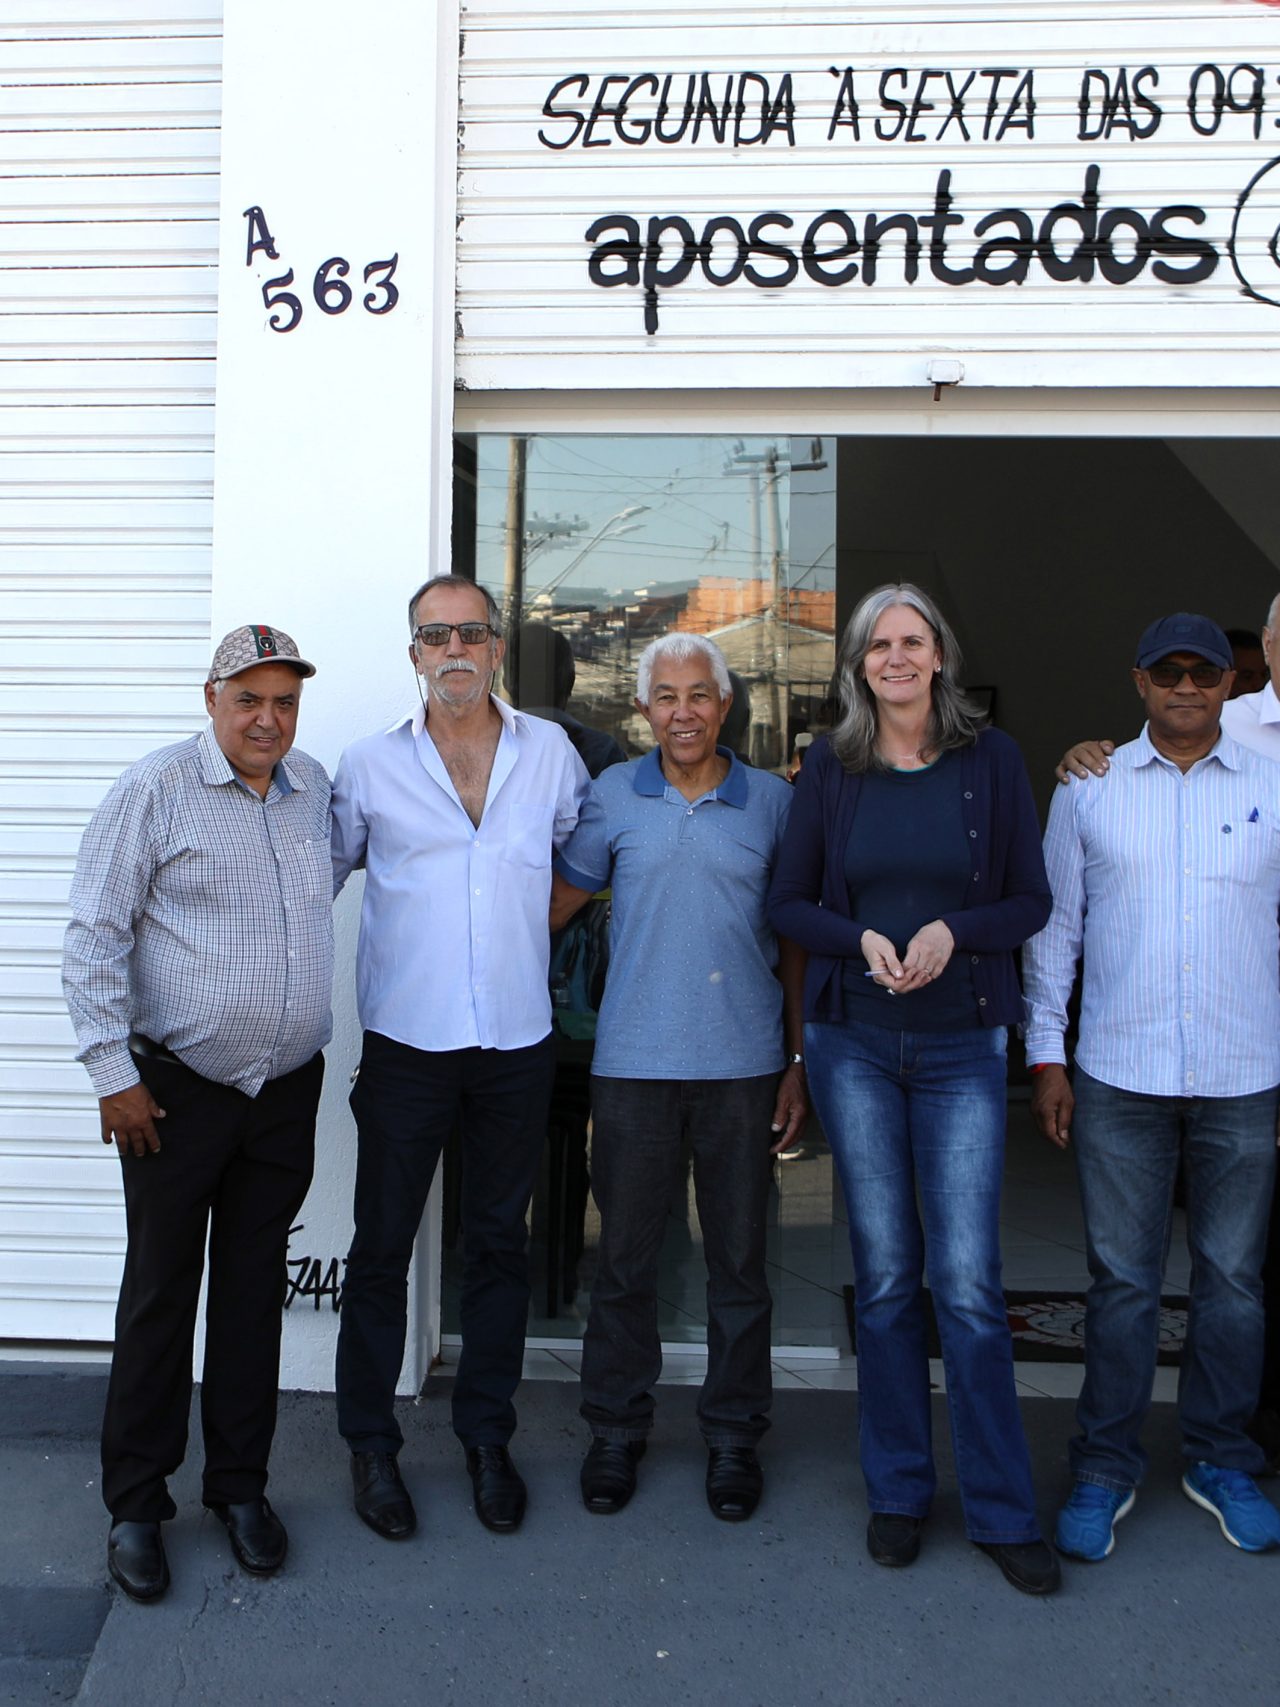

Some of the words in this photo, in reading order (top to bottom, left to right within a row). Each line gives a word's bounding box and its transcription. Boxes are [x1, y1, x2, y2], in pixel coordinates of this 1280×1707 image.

[538, 71, 797, 150] SEGUNDA
[874, 67, 1037, 142] SEXTA
[1076, 65, 1166, 142] DAS
[243, 206, 280, 266] A
[261, 252, 399, 333] 563
